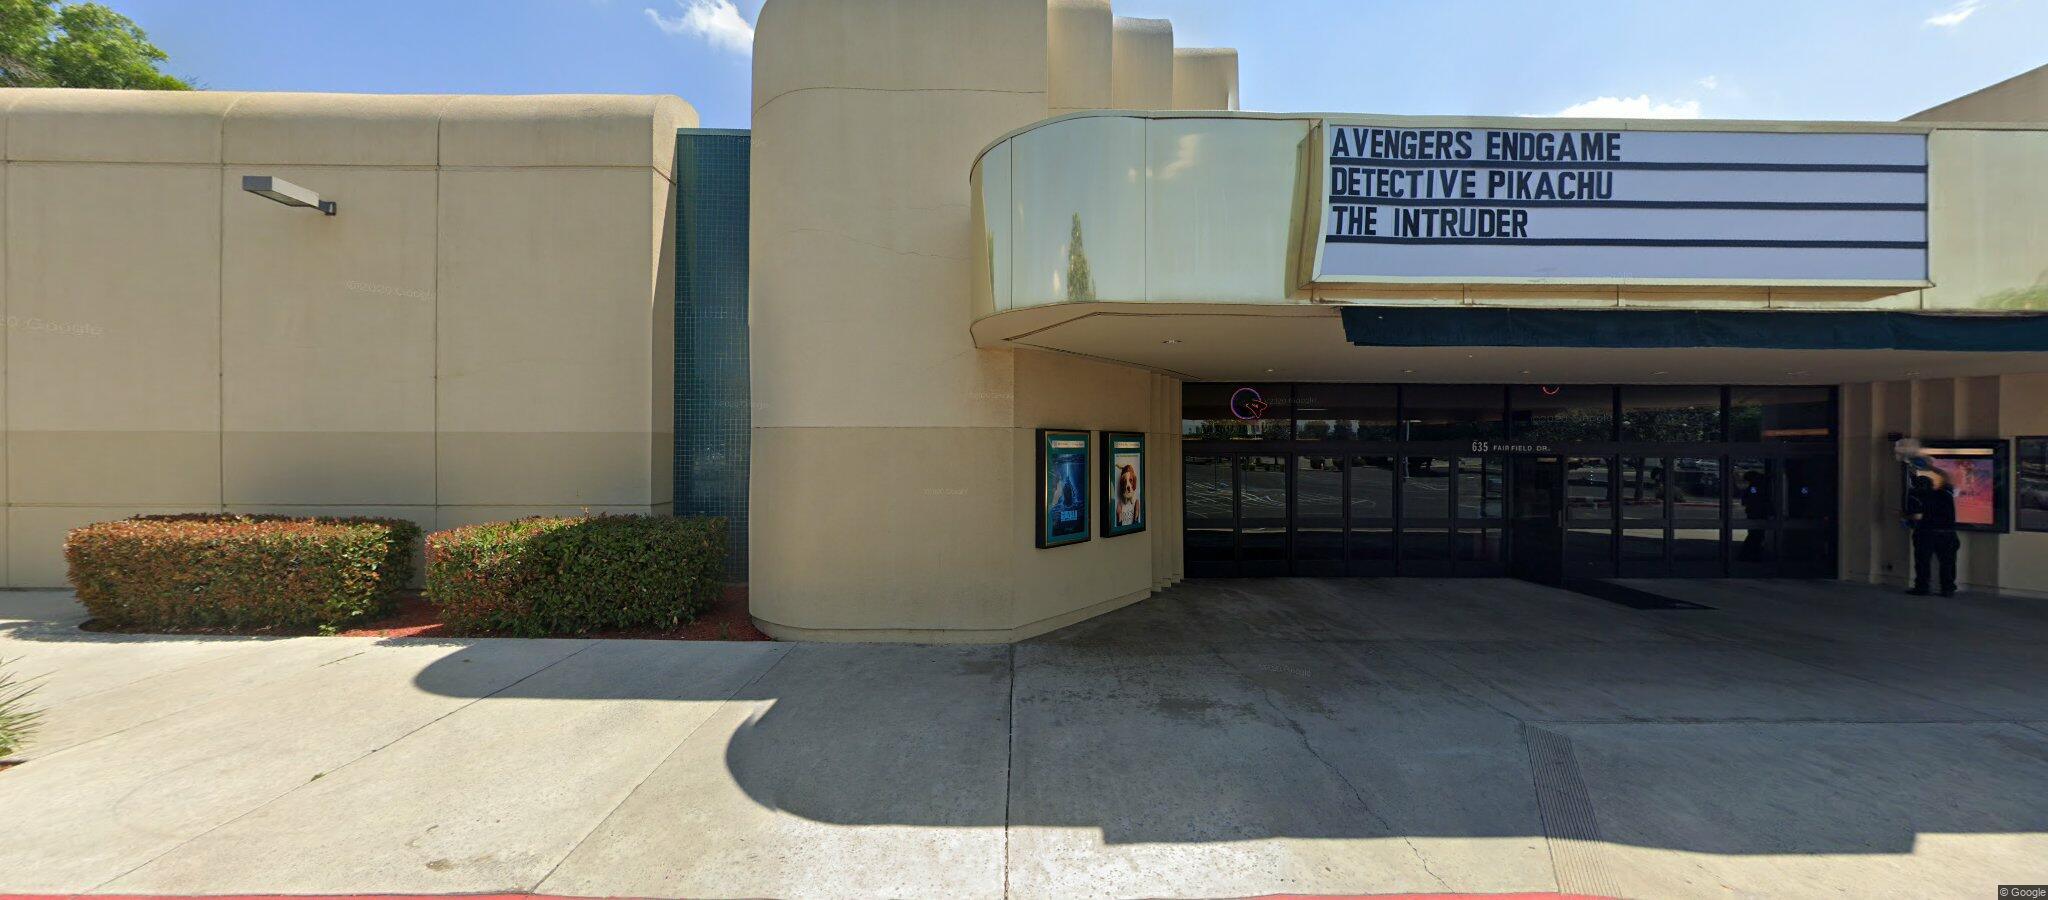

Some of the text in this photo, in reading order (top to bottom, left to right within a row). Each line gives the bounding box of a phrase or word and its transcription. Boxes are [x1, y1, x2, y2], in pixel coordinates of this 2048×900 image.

[1332, 127, 1621, 161] AVENGERS ENDGAME
[1332, 167, 1613, 200] DETECTIVE PIKACHU
[1332, 205, 1529, 238] THE INTRUDER
[1472, 441, 1489, 452] 635
